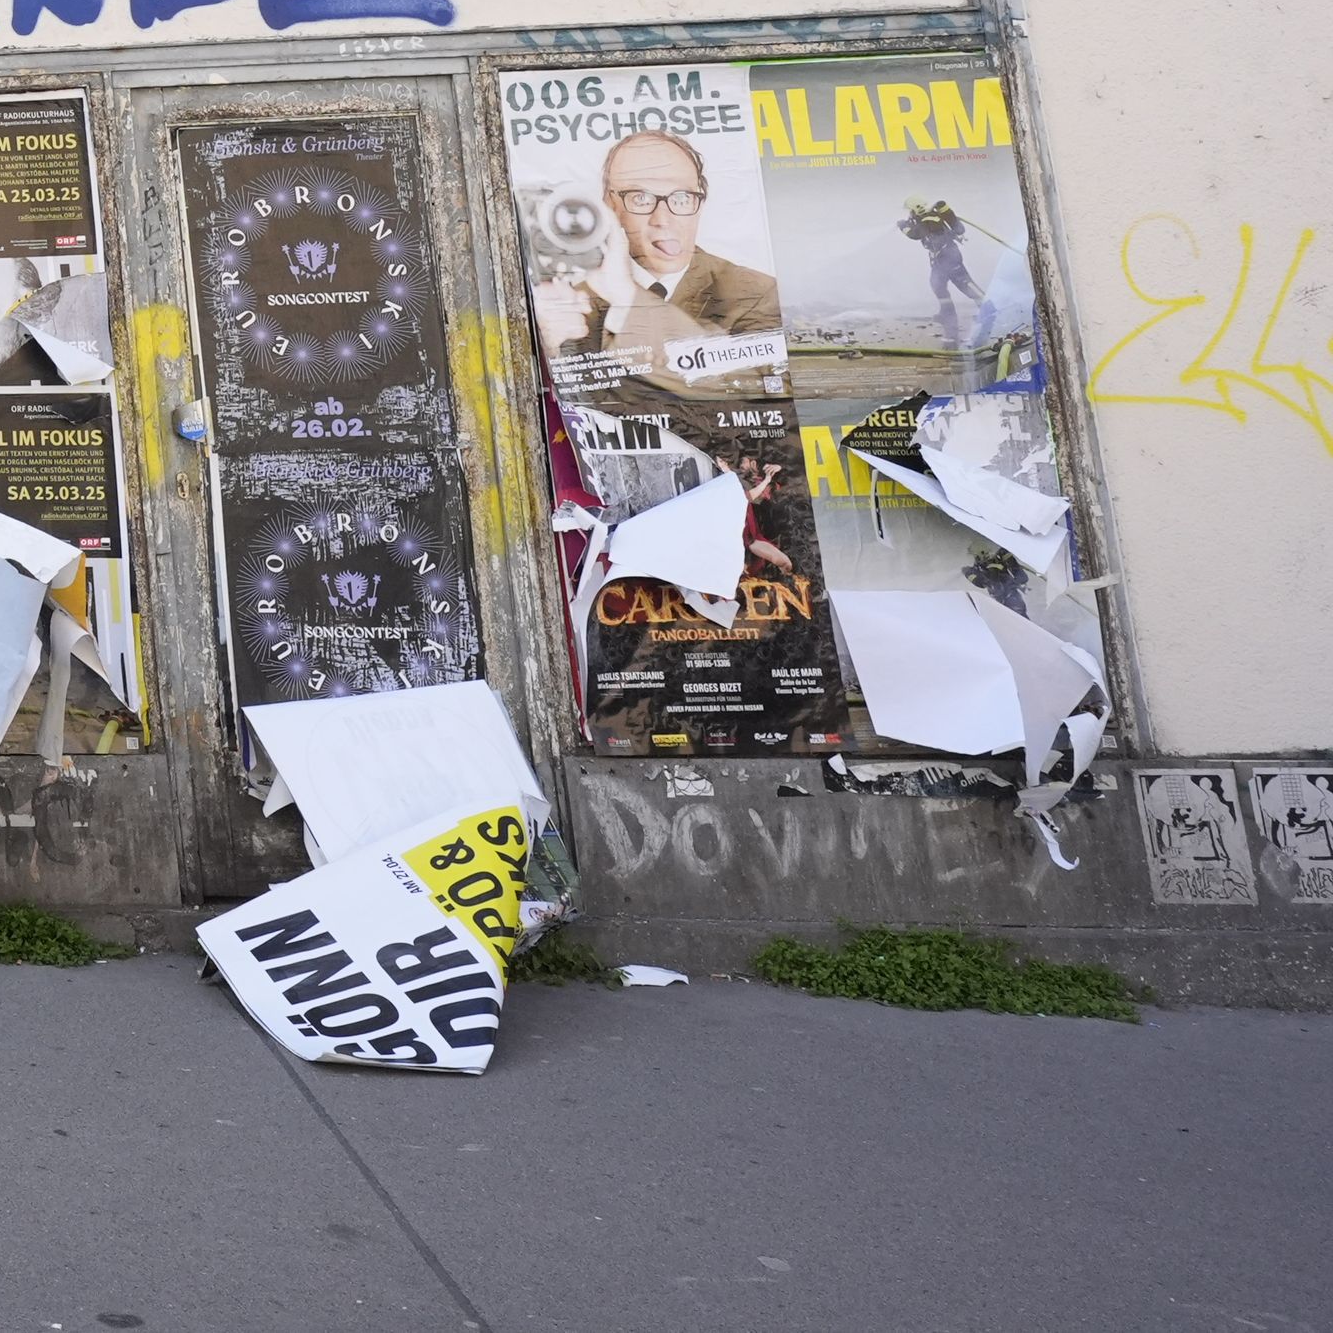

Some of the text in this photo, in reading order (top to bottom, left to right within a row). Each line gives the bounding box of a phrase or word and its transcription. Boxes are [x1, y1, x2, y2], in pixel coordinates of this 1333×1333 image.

[935, 62, 969, 70] Diagonale
[3, 108, 76, 121] RADIOKULTURHAUS
[750, 77, 1012, 158] ALARM
[510, 104, 746, 146] PSYCHOSEE
[16, 133, 78, 151] FOKUS
[302, 133, 385, 155] Grünberg
[10, 187, 81, 203] 25.03.25
[56, 236, 76, 245] ORF
[267, 290, 370, 307] SONGCONTEST
[707, 344, 775, 363] THEATER
[313, 397, 344, 416] ab
[291, 417, 372, 438] 26.02.
[717, 412, 730, 428] 2.
[732, 411, 762, 427] MAI
[12, 430, 36, 447] IM
[40, 429, 104, 447] FOKUS
[768, 428, 786, 438] UHR
[6, 458, 27, 466] ORGEL
[28, 458, 53, 466] MARTIN
[53, 457, 92, 465] HASELBÖCK
[93, 457, 105, 465] MIT
[10, 450, 32, 458] TEXTEN
[48, 449, 69, 457] ERNST
[69, 449, 89, 457] JANDL
[89, 449, 104, 457] UND
[6, 485, 106, 501] SA 25.03.25
[79, 538, 100, 547] ORF
[596, 574, 813, 627] CAREN
[303, 626, 410, 640] SONGCONTEST
[649, 627, 761, 642] TANGOBALLETT
[771, 667, 823, 678] RAÚL DE MARR
[683, 681, 743, 693] GEORGES BIZET
[375, 924, 503, 1051] DIR
